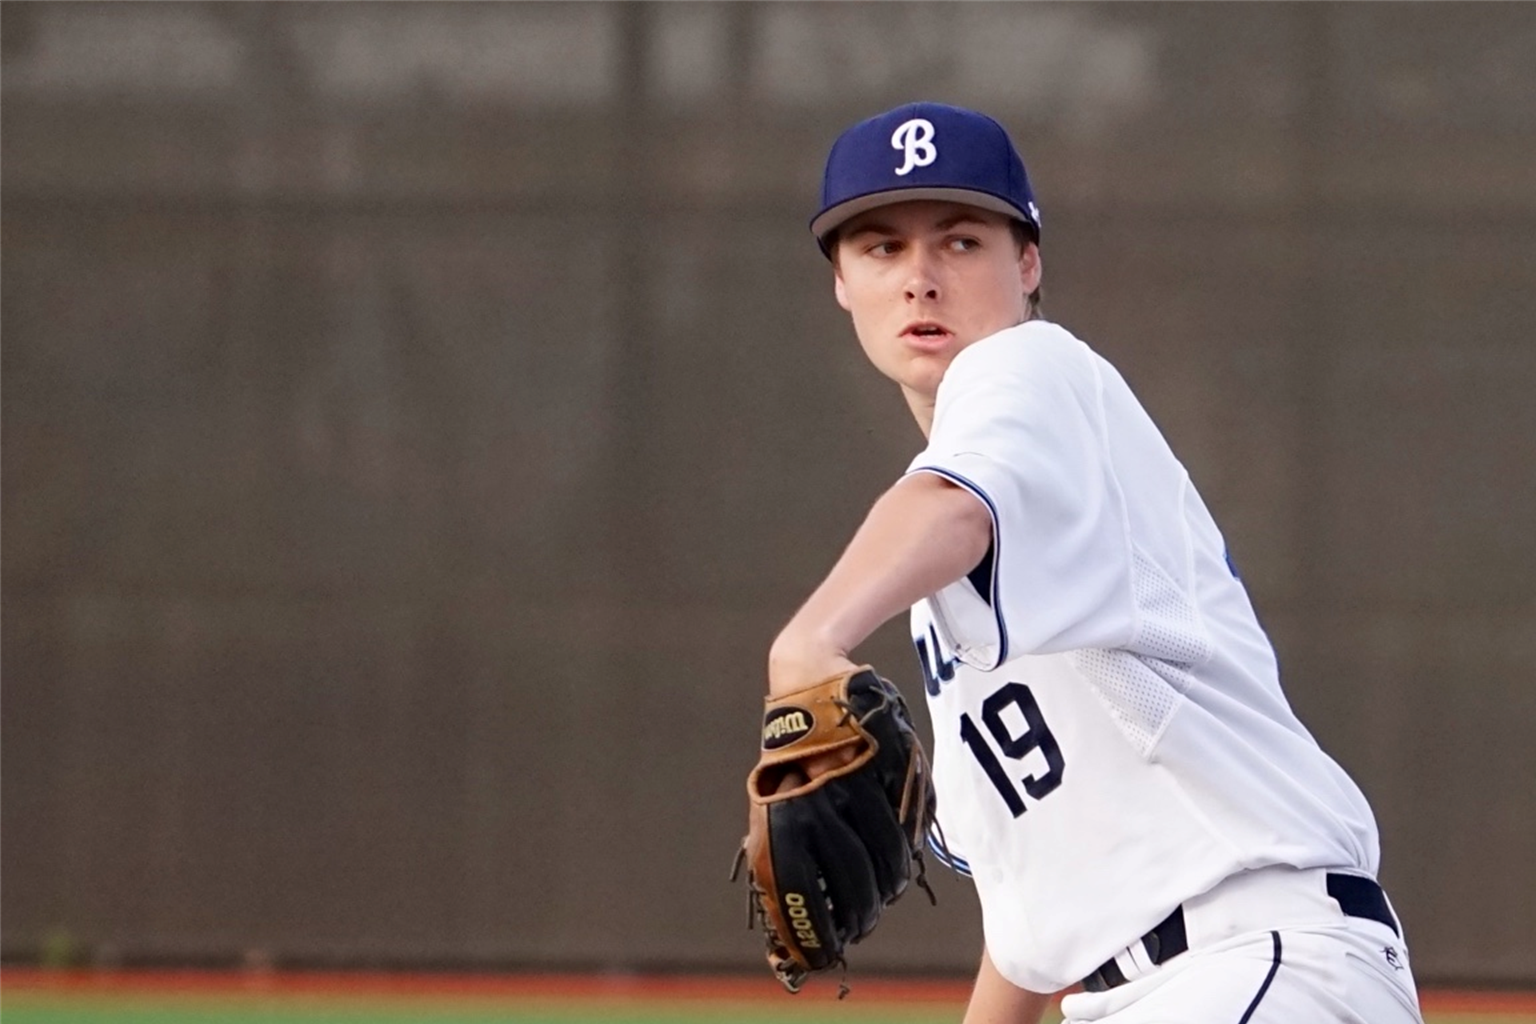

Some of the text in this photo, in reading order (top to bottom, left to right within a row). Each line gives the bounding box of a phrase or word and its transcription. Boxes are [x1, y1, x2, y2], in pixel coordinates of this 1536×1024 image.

[891, 118, 938, 176] B
[960, 681, 1066, 819] 19
[785, 893, 821, 948] A2000
